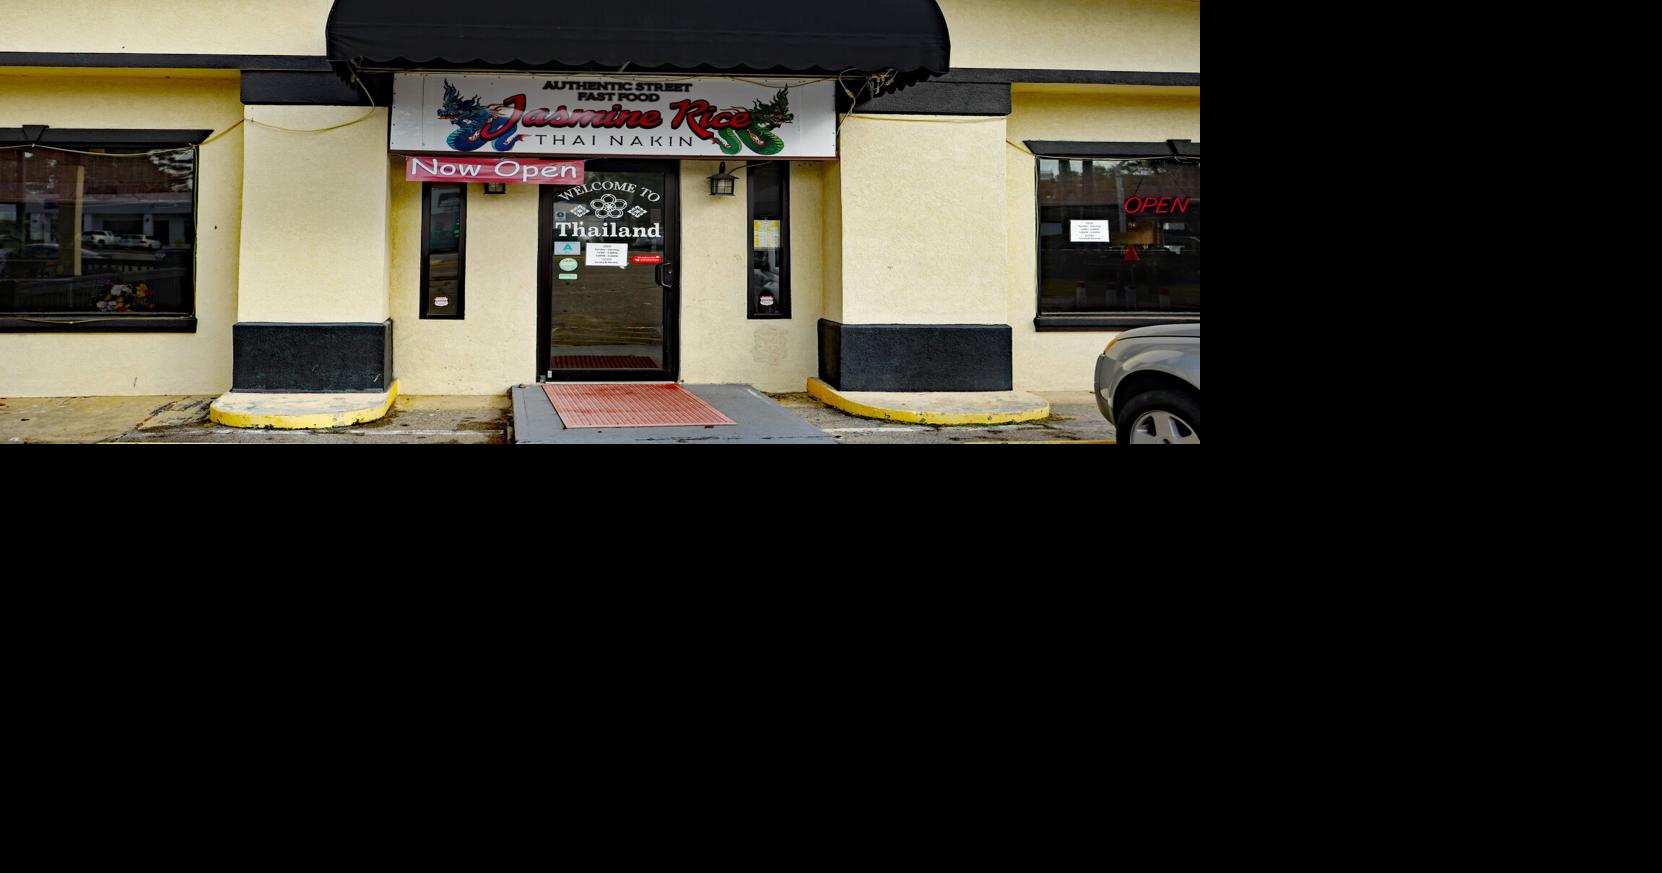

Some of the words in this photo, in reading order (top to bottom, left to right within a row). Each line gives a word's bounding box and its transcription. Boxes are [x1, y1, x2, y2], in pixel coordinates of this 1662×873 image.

[542, 80, 633, 92] AUTHENTIC
[635, 82, 693, 93] STREET
[577, 91, 617, 102] FAST
[618, 92, 661, 103] FOOD
[481, 93, 663, 142] Jasmine
[669, 98, 752, 141] Rice
[535, 134, 596, 146] THAI
[610, 135, 693, 147] NAKIN
[411, 157, 482, 176] Now
[494, 160, 577, 182] Open
[558, 181, 637, 202] WELCOME
[640, 187, 661, 202] TO
[1123, 195, 1191, 214] OPEN
[555, 221, 661, 238] Thailand
[562, 242, 574, 252] A
